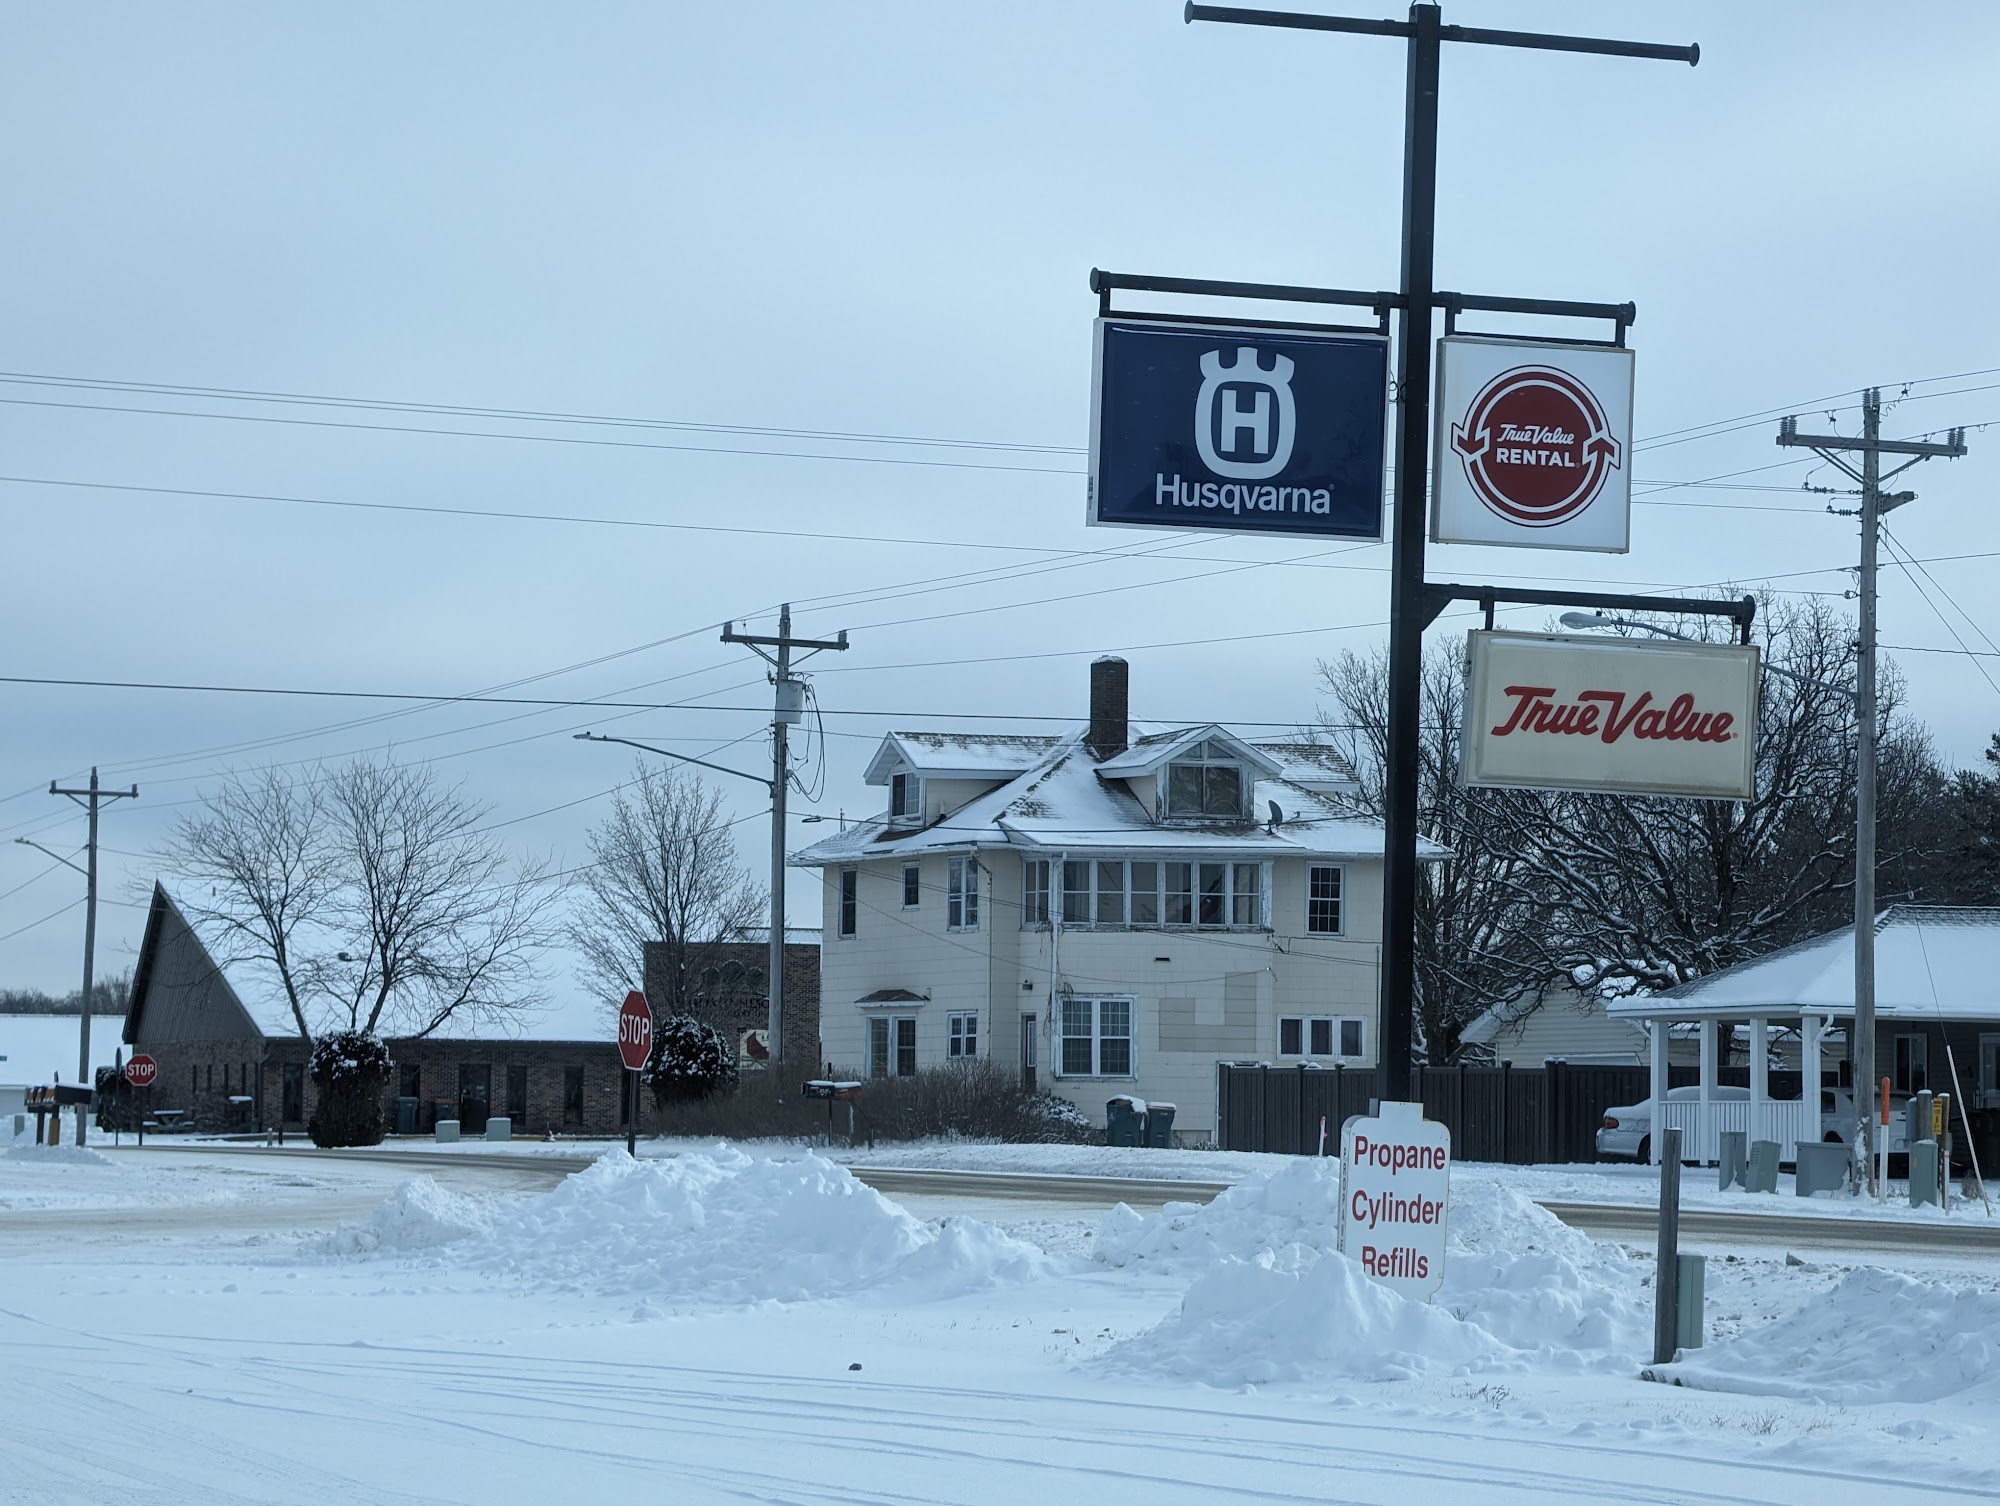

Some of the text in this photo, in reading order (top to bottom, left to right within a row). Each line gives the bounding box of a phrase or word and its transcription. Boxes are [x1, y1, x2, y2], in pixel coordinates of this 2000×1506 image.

[1220, 389, 1271, 455] H
[1496, 423, 1575, 445] True Value
[1496, 448, 1575, 468] RENTAL
[1155, 472, 1331, 515] Husqvarna
[1490, 685, 1735, 744] True Value
[620, 1013, 650, 1046] STOP
[127, 1063, 155, 1076] STOP
[1353, 1135, 1446, 1176] Propane
[1351, 1189, 1444, 1230] Cylinder
[1361, 1245, 1429, 1279] Refills
